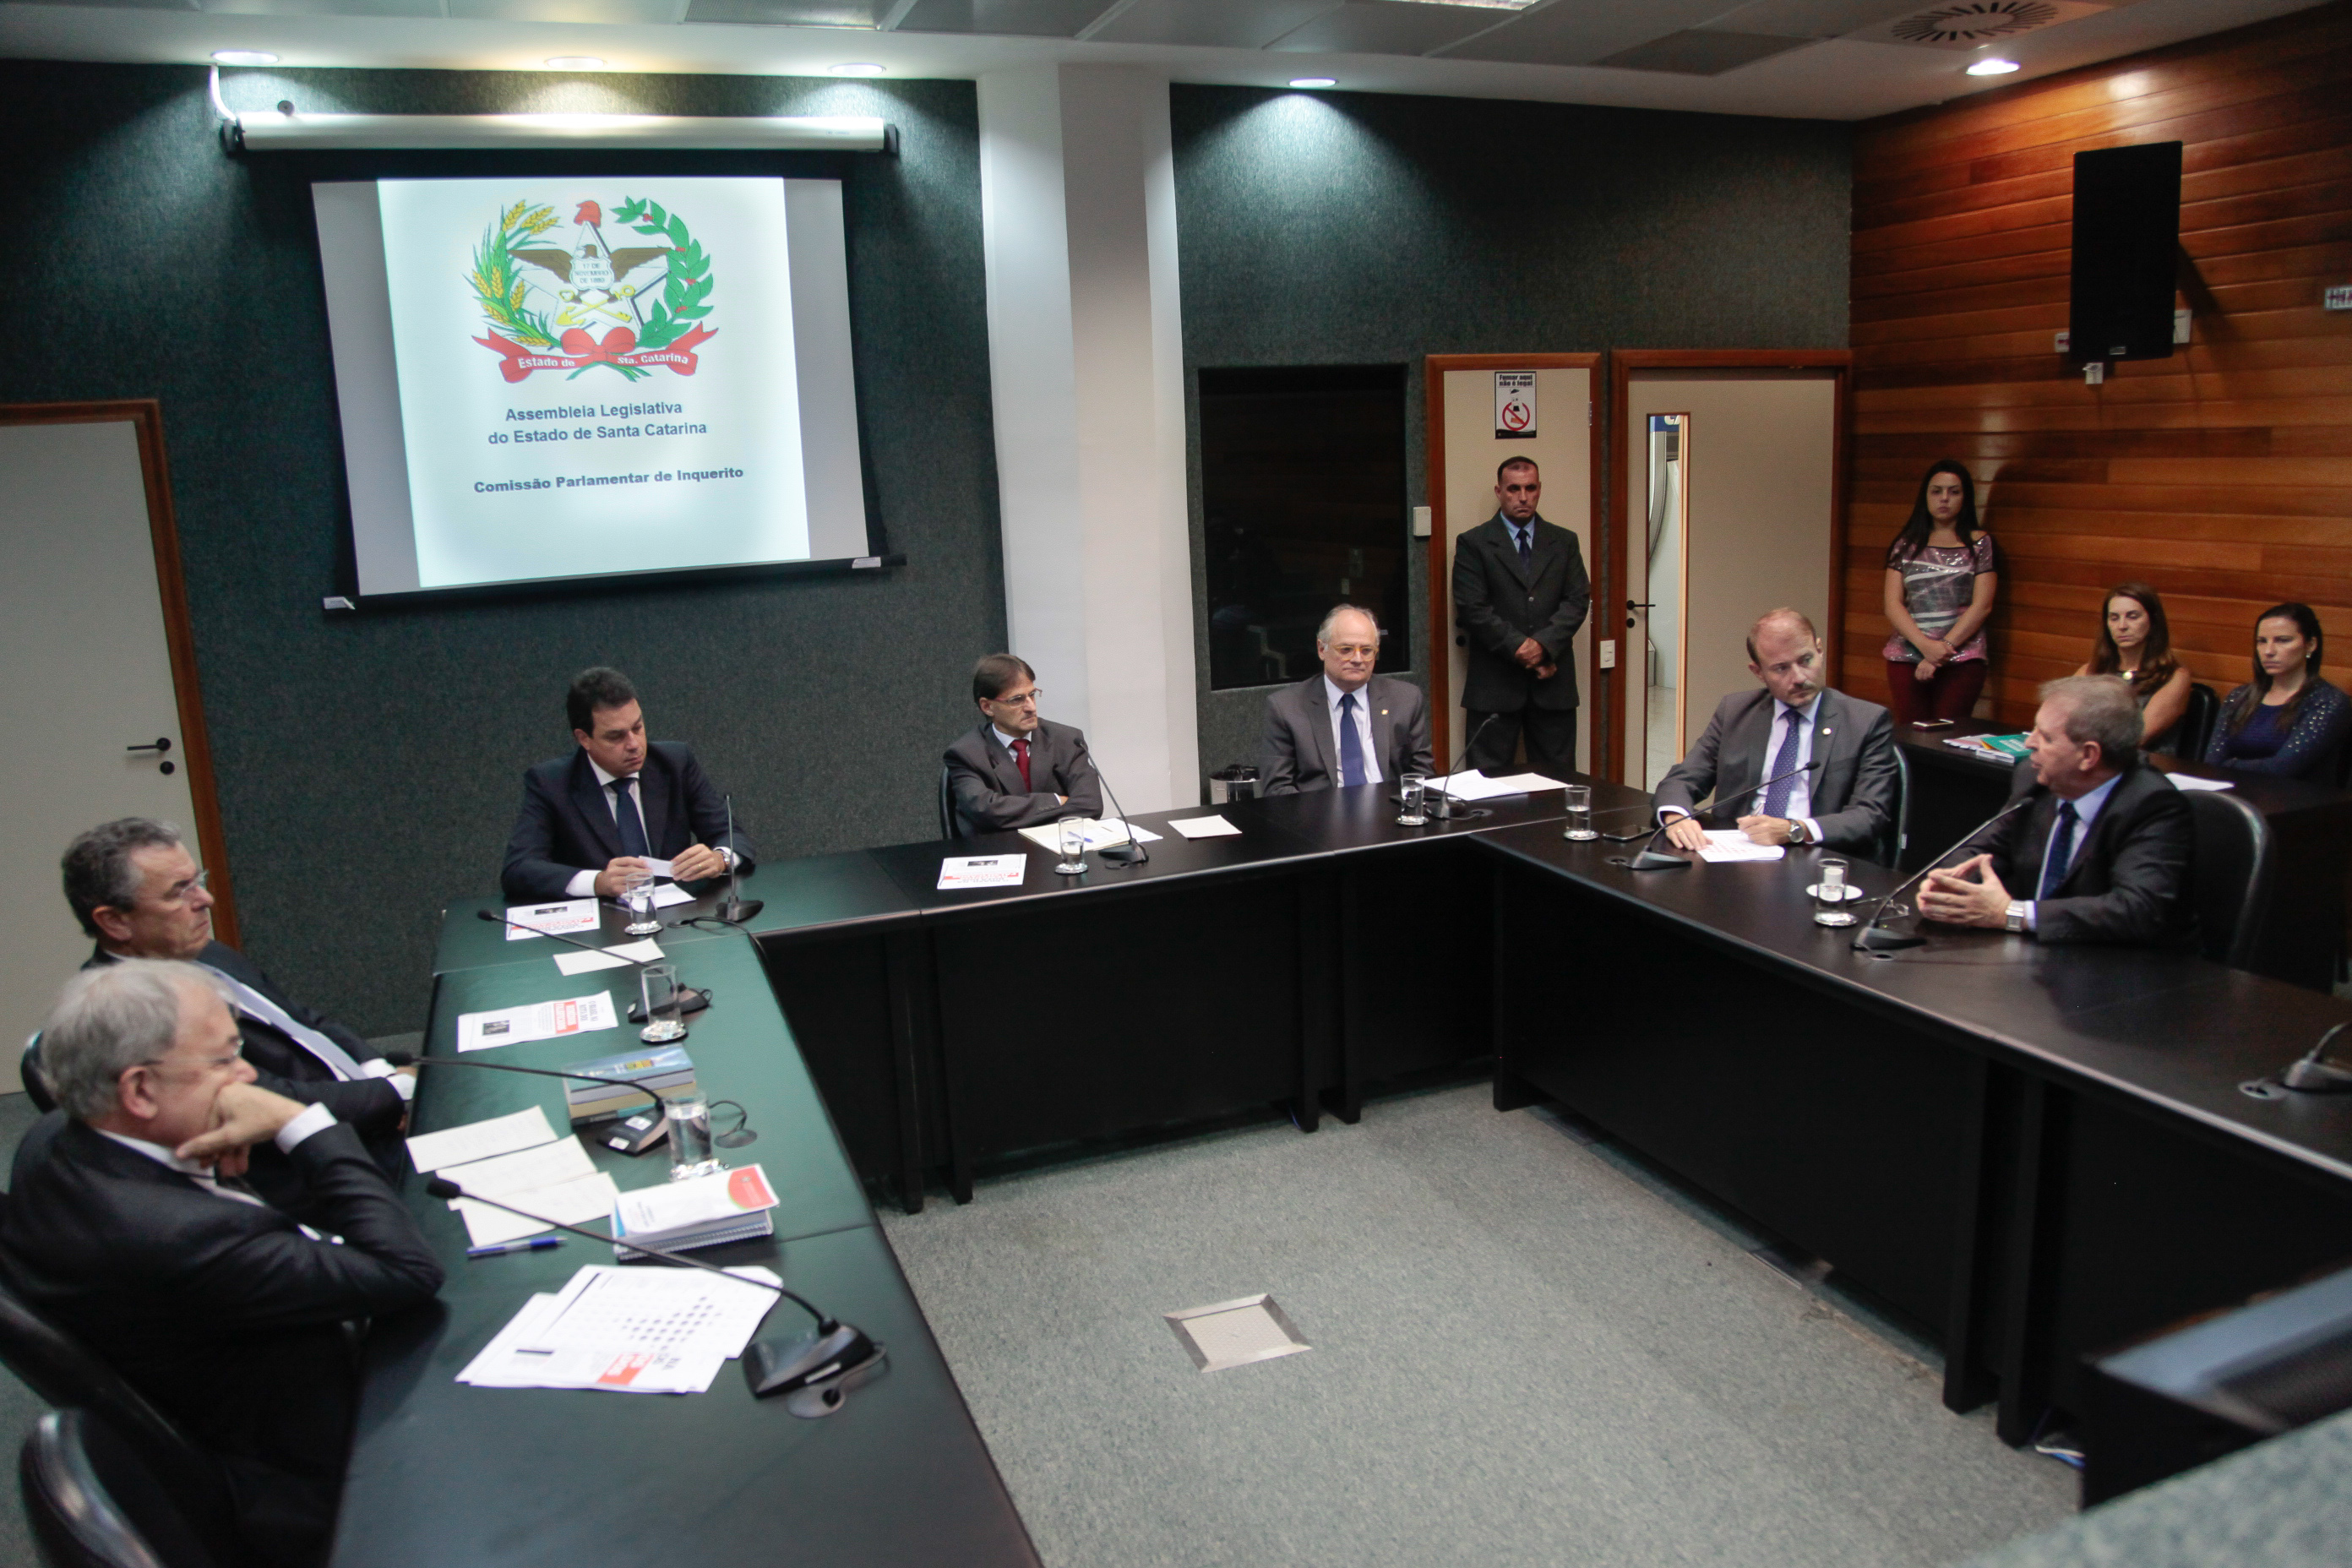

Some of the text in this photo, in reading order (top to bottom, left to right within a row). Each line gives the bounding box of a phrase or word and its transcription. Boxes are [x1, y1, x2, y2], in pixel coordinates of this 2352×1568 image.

[517, 357, 575, 369] Estado de
[617, 354, 689, 365] Sta. Catarina
[505, 401, 683, 422] Assembleia Legislativa
[487, 422, 707, 444] do Estado de Santa Catarina
[473, 467, 744, 493] Comissão Parlamentar de Inquerito
